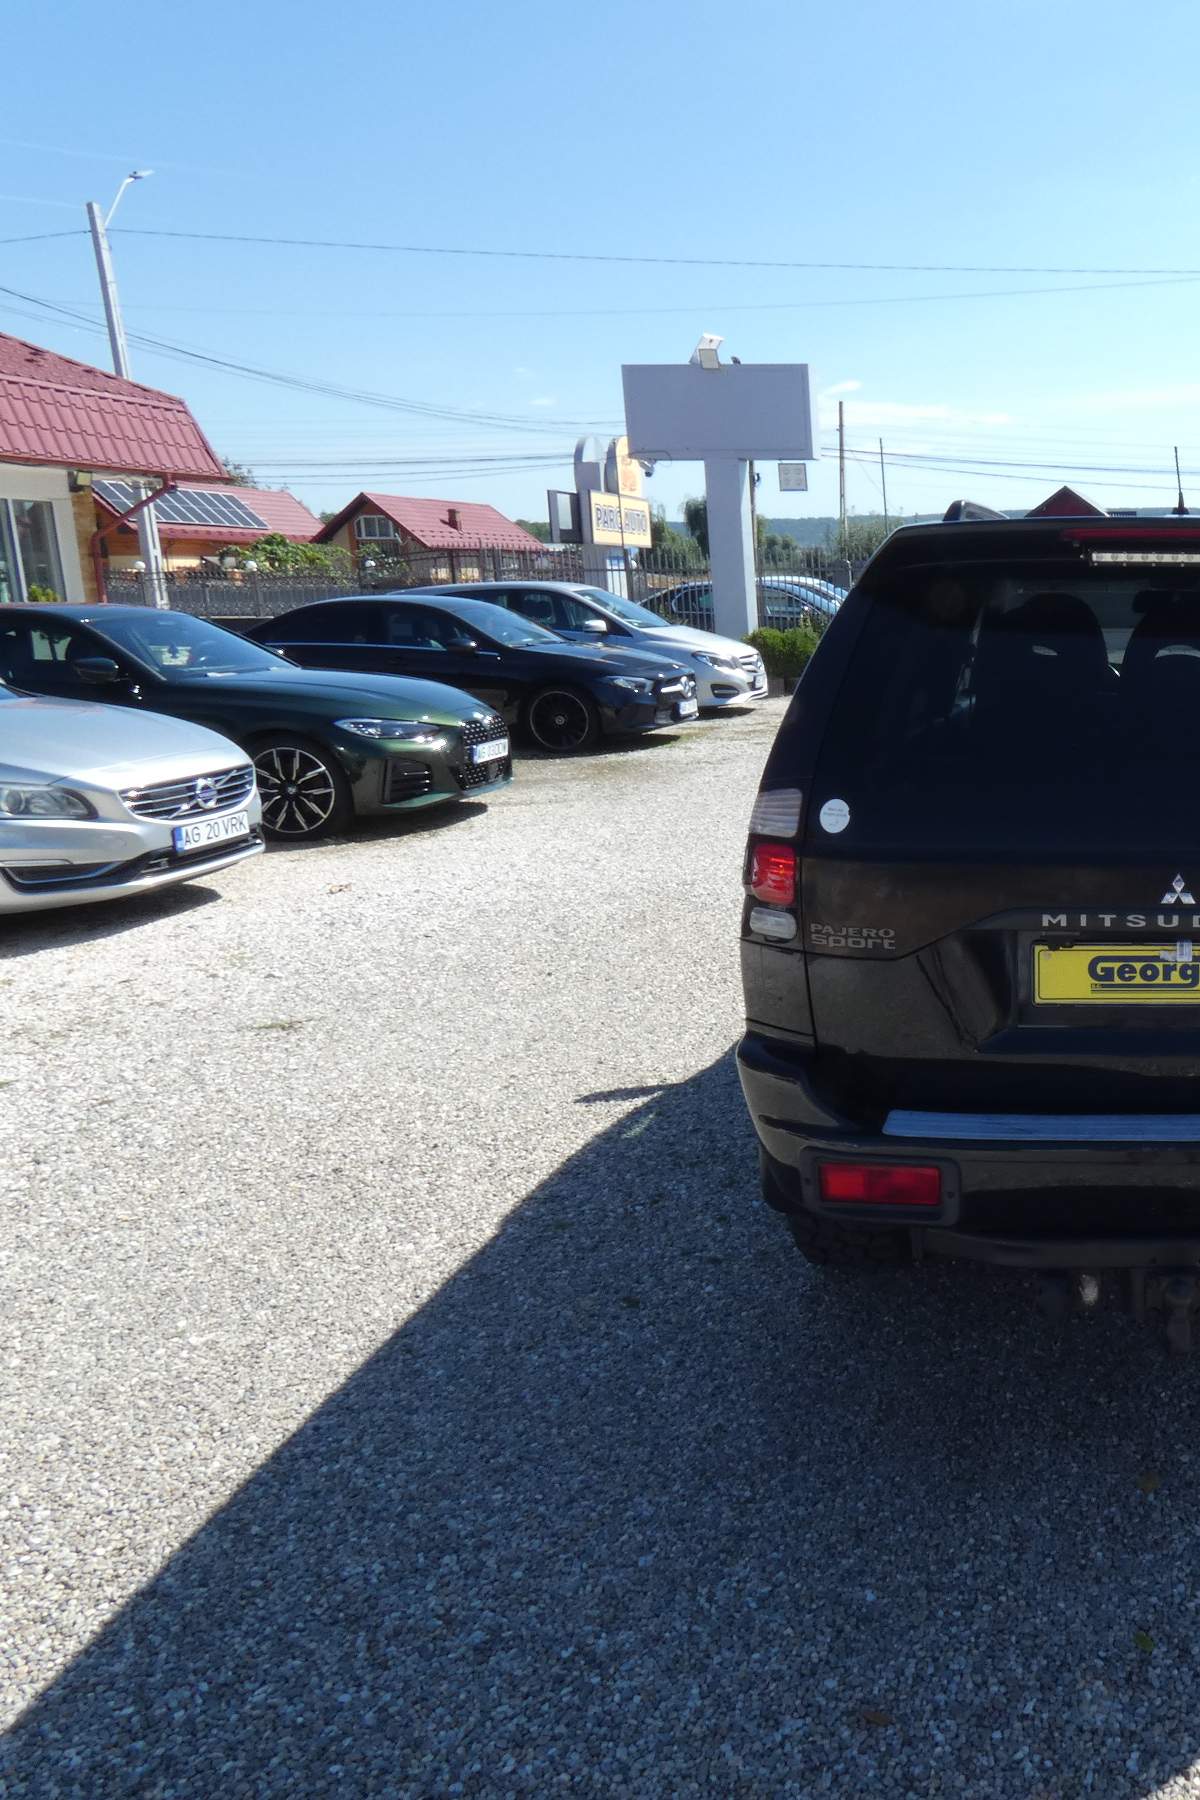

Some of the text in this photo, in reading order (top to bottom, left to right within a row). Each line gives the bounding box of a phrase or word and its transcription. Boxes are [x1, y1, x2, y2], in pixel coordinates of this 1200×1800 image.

[594, 503, 648, 536] PARC AUTO
[184, 815, 248, 845] AG 20 VRK
[810, 923, 896, 938] PAJERO
